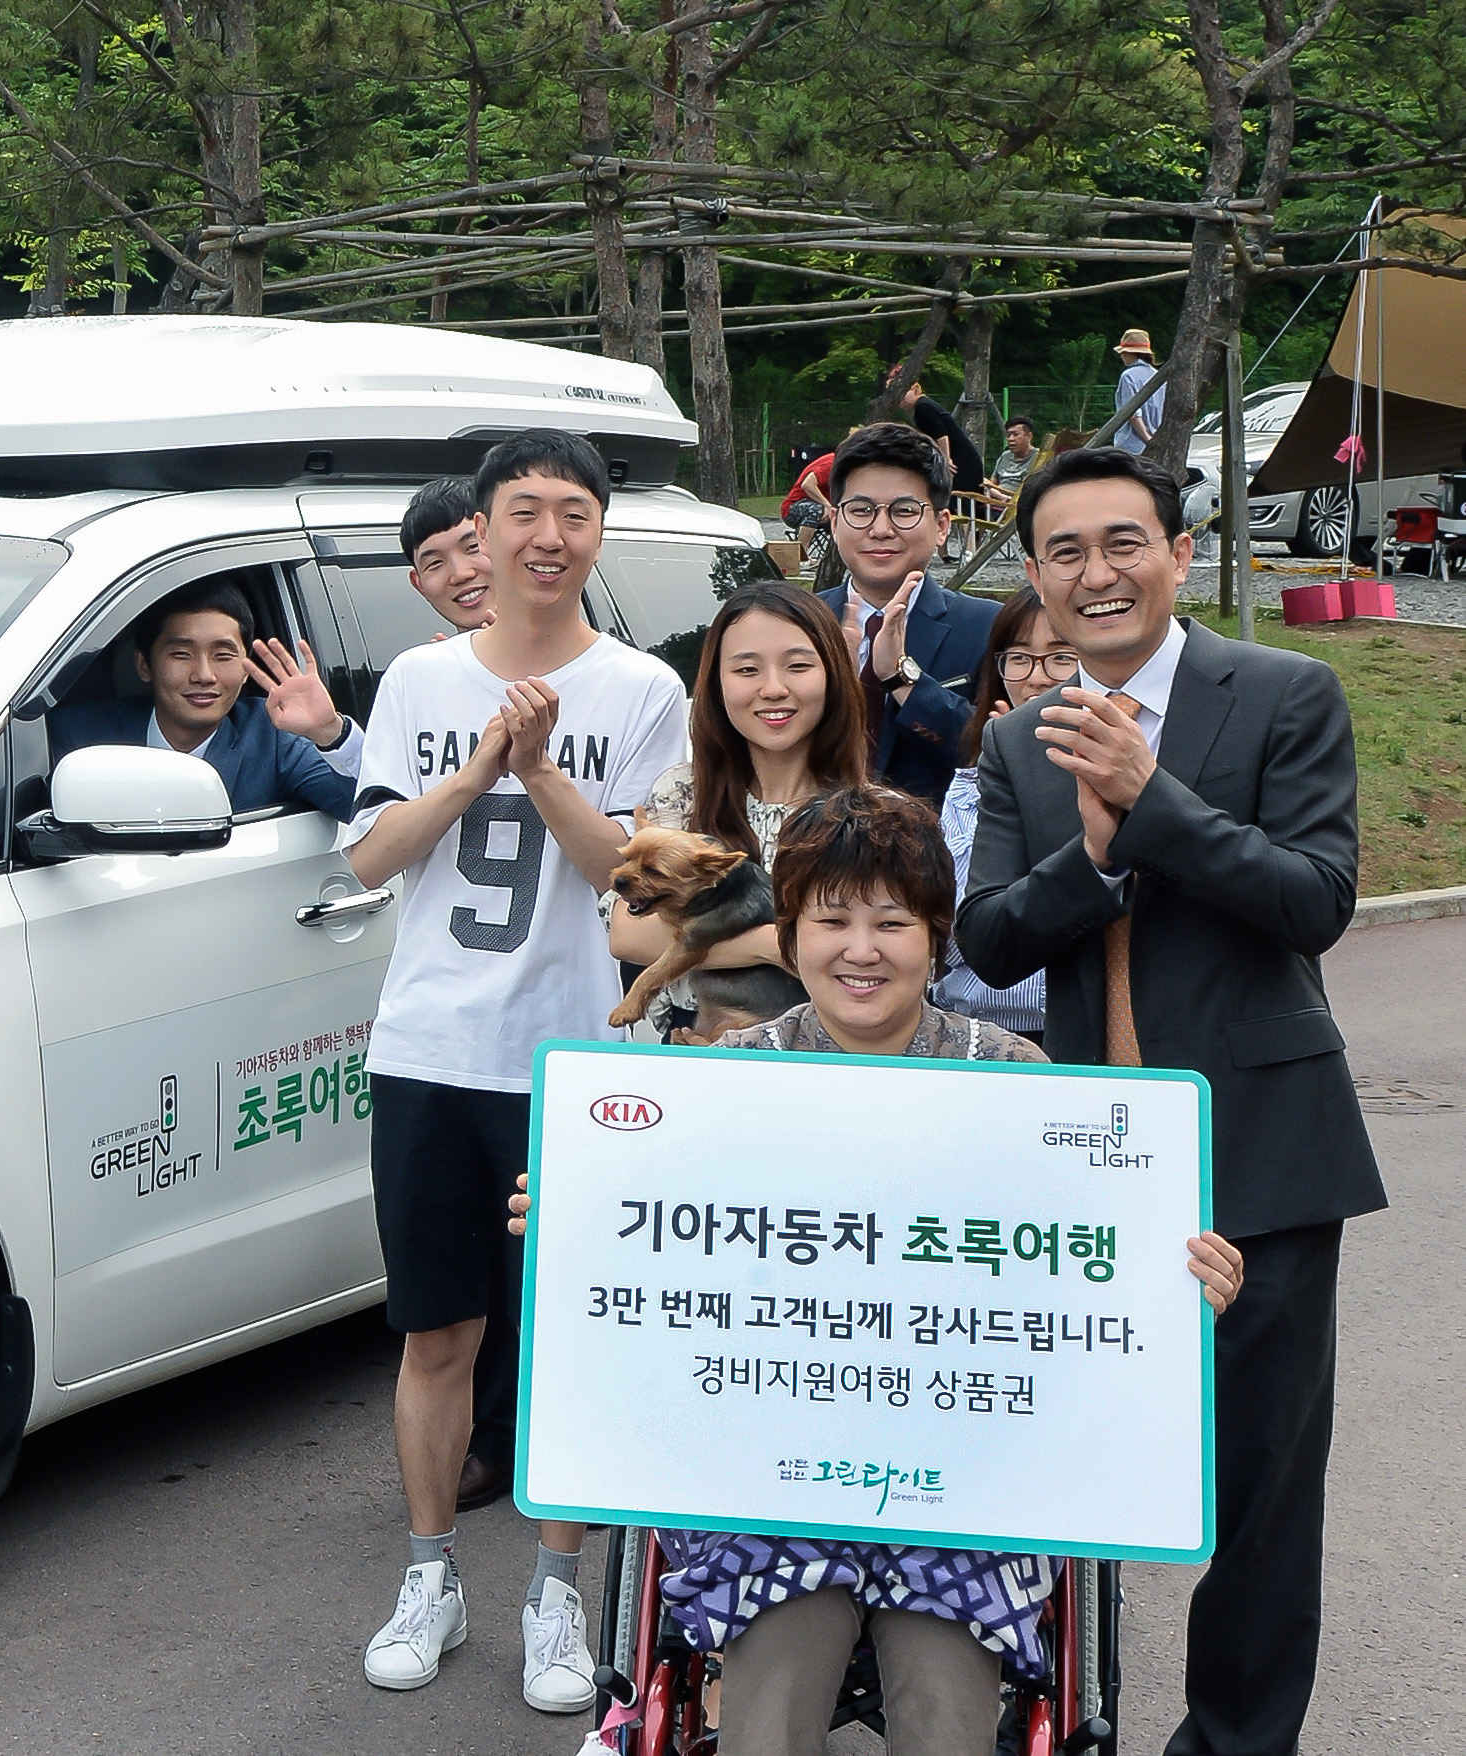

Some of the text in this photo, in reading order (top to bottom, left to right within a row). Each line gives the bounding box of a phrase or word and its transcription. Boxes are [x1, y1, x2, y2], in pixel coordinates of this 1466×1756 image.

[449, 793, 547, 953] 9
[236, 1043, 300, 1079] 기아자동차와
[303, 1030, 343, 1061] 함께하는
[233, 1050, 373, 1152] 초록여행
[602, 1102, 650, 1123] KIA
[91, 1133, 171, 1179] GREEN
[97, 1131, 123, 1147] BETTER
[124, 1126, 138, 1138] WAY
[140, 1122, 149, 1132] TO
[1043, 1131, 1122, 1149] GREEN
[137, 1152, 202, 1197] LIGHT
[1089, 1151, 1154, 1168] LIGHT
[617, 1200, 1116, 1283] 기아자동차 초록여행
[587, 1286, 1144, 1354] 3만 번째 고객님께 감사드립니다.
[692, 1355, 1035, 1415] 경비지원여행 상품권
[812, 1459, 945, 1516] 그린라이트
[890, 1491, 944, 1504] Green Light
